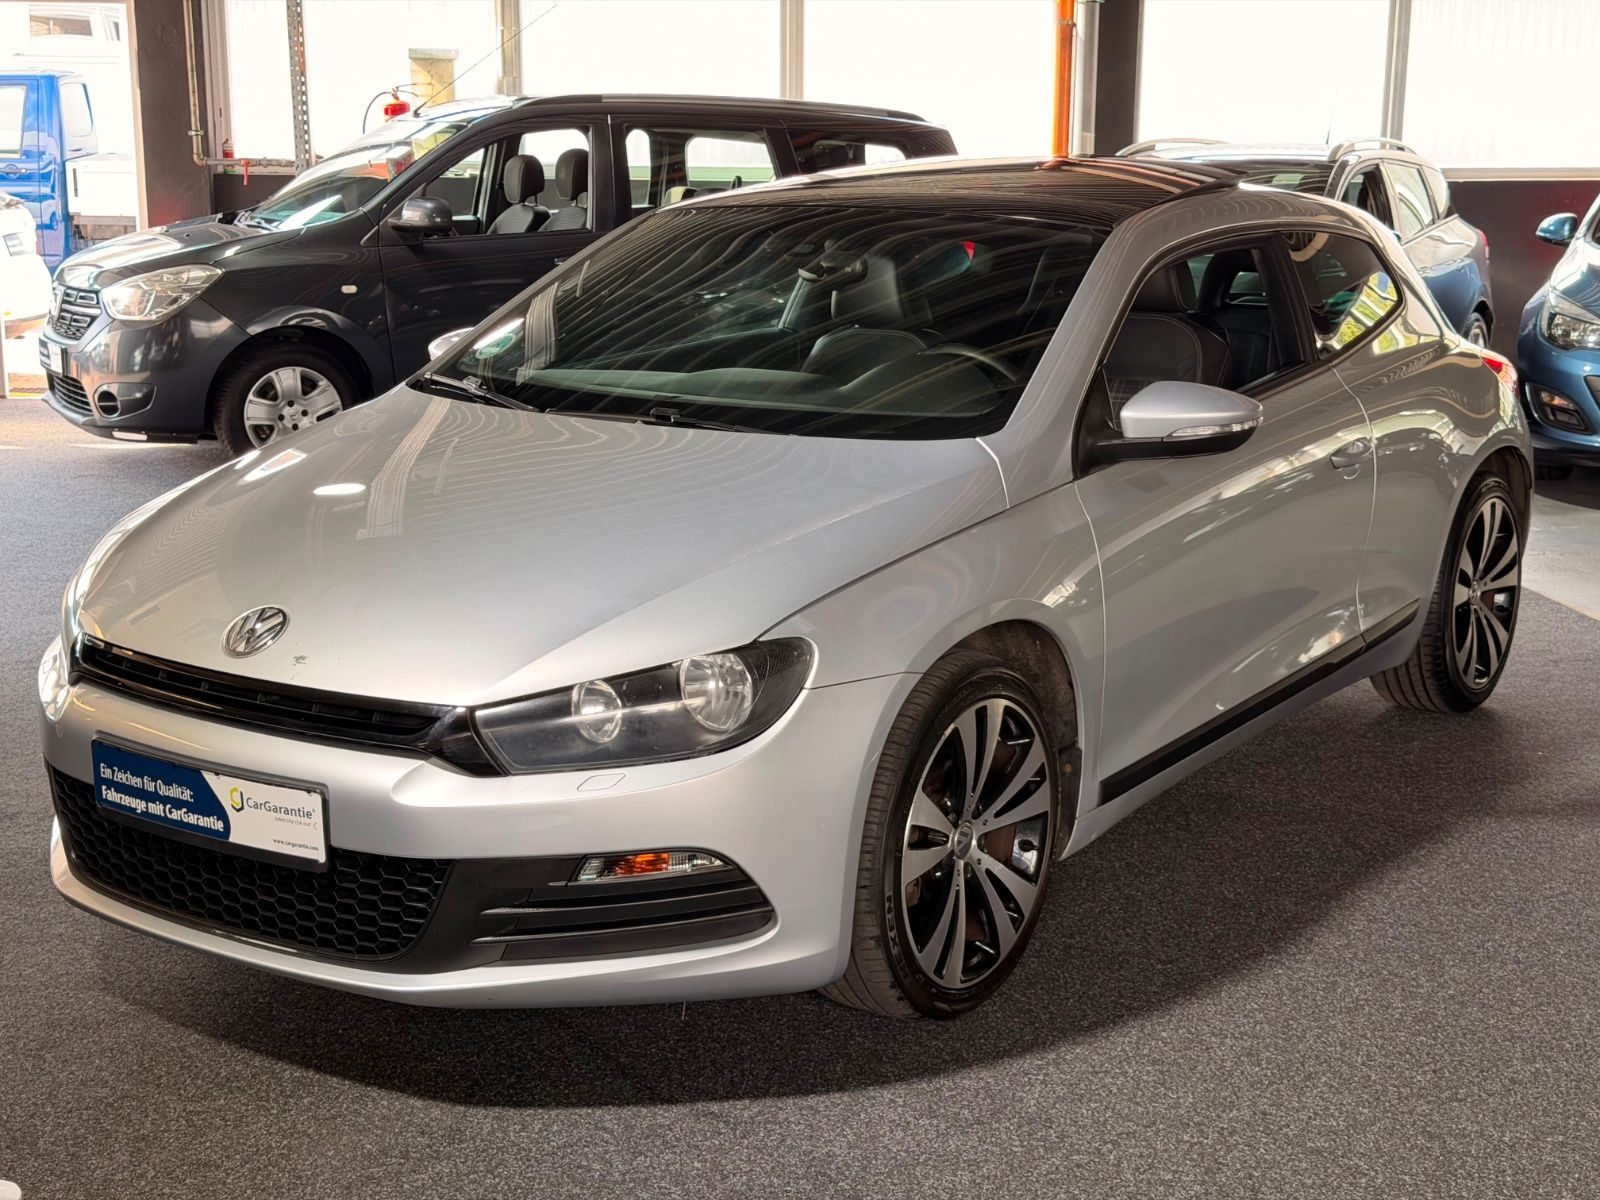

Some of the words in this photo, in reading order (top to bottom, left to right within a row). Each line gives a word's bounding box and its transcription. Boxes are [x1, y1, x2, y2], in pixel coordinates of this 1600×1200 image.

[100, 763, 112, 780] Ein
[113, 767, 142, 788] Zeichen
[144, 775, 156, 793] für
[157, 780, 194, 802] Qualität:
[101, 785, 147, 813] Fahrzeuge
[148, 801, 165, 817] mit
[165, 805, 224, 832] CarGarantie
